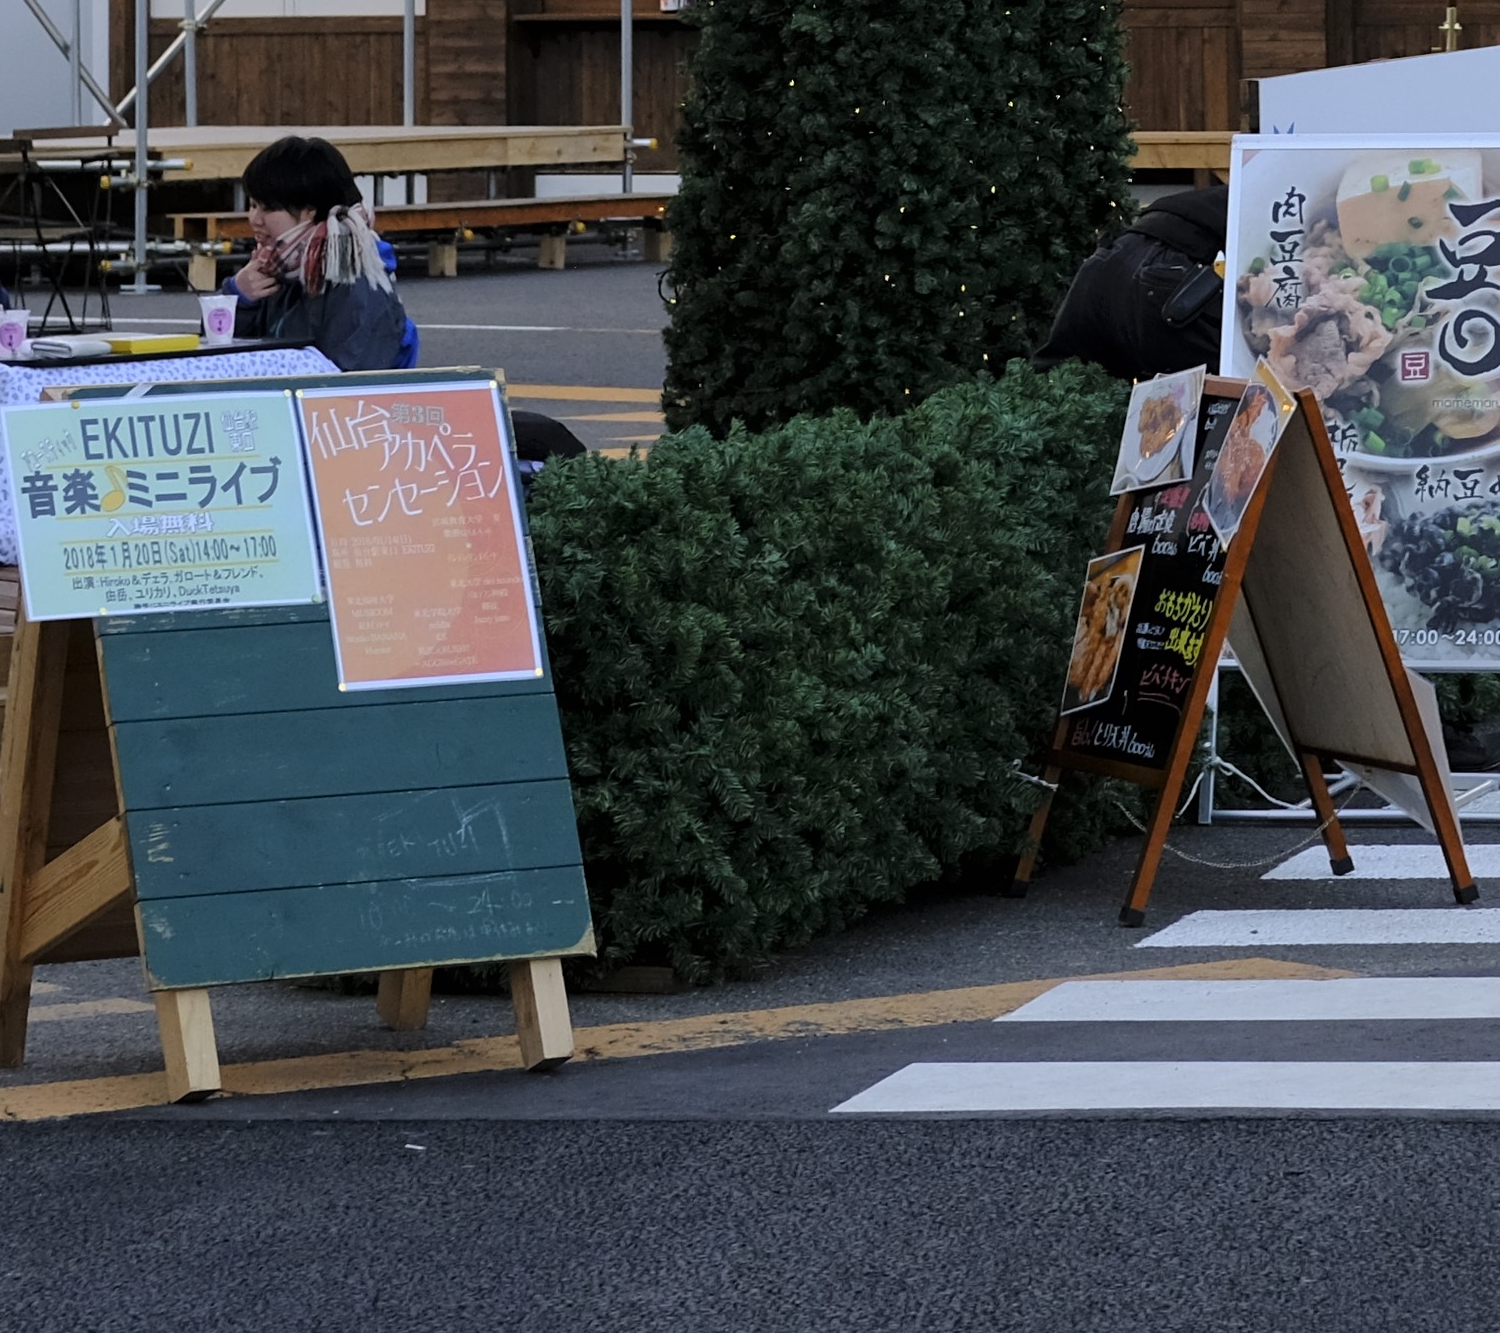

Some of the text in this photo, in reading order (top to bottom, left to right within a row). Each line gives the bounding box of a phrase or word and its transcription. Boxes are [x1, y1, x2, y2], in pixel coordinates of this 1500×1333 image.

[1265, 185, 1306, 310] 肉豆腐
[80, 411, 215, 460] EKITUZI
[311, 400, 390, 460] 仙台
[391, 403, 444, 426] 第3回
[373, 423, 476, 472] アカペラ
[343, 461, 503, 526] センセーション
[107, 512, 214, 537] 入場無料
